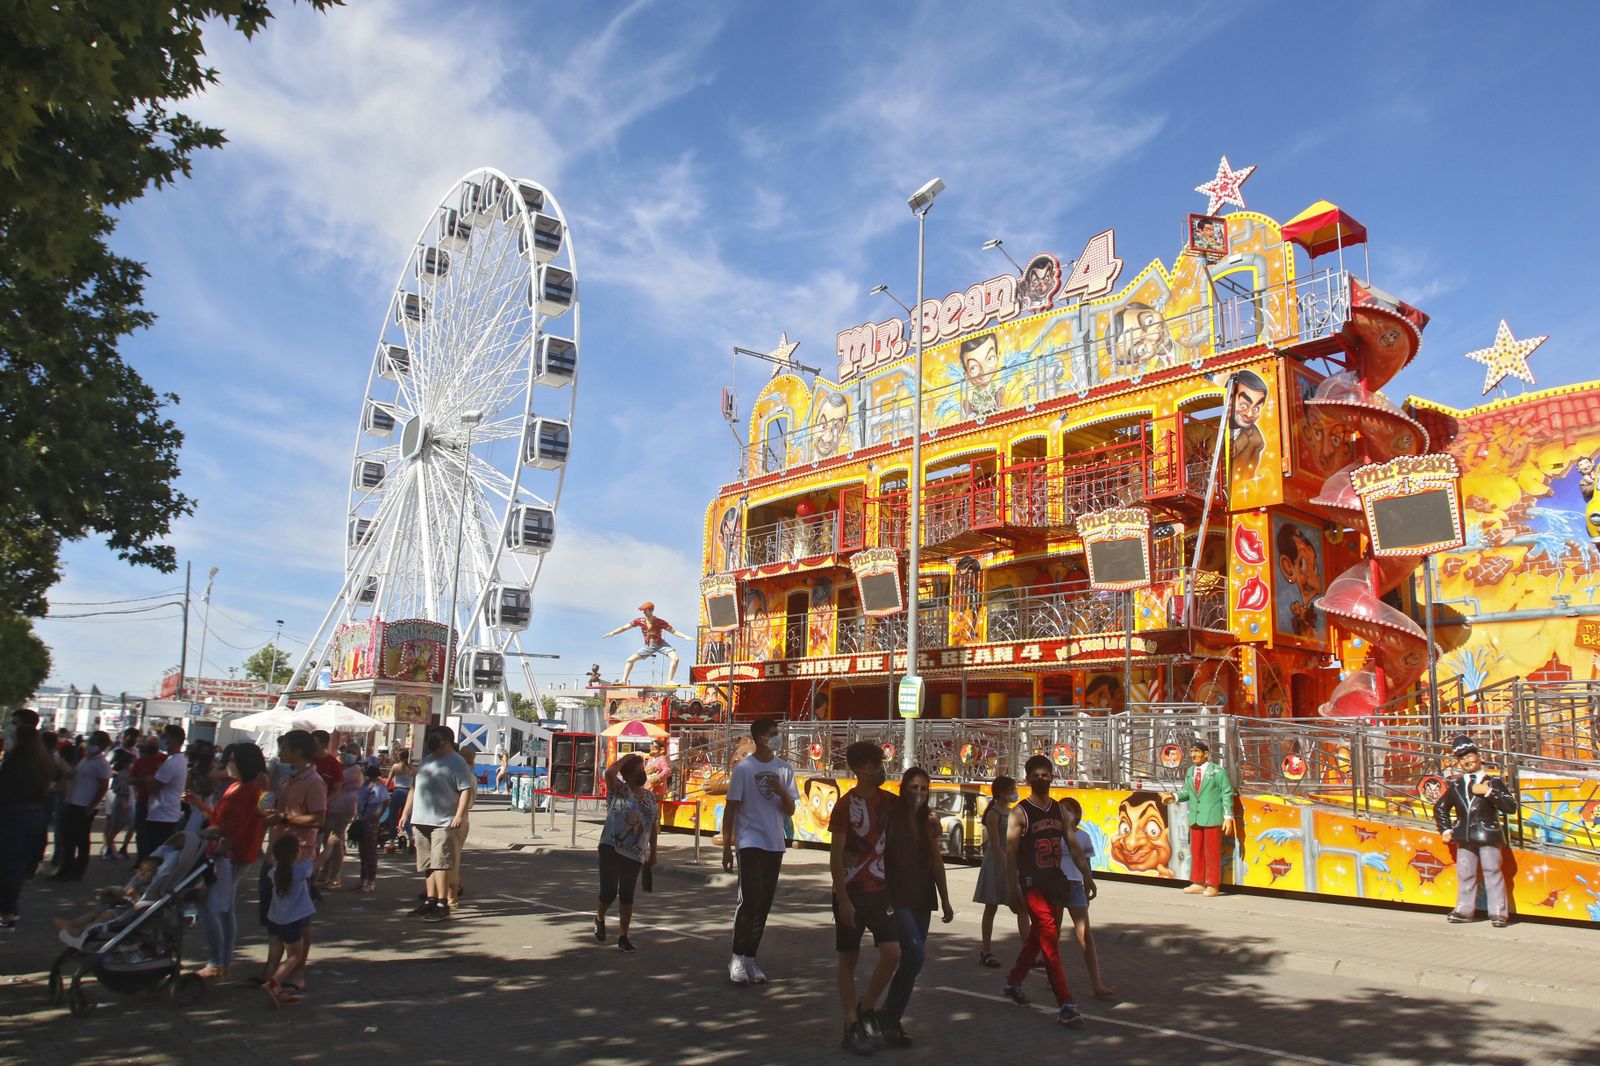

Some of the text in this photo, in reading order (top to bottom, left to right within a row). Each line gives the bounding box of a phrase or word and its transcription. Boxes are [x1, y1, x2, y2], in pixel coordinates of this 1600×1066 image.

[910, 274, 1020, 348] Bean
[1059, 229, 1123, 301] 4
[1396, 458, 1452, 475] Bean
[1107, 511, 1144, 525] Bean
[764, 664, 783, 677] EL
[787, 659, 851, 675] SHOW
[856, 656, 884, 671] DE
[941, 648, 1014, 666] BEAN
[1020, 644, 1043, 661] 4
